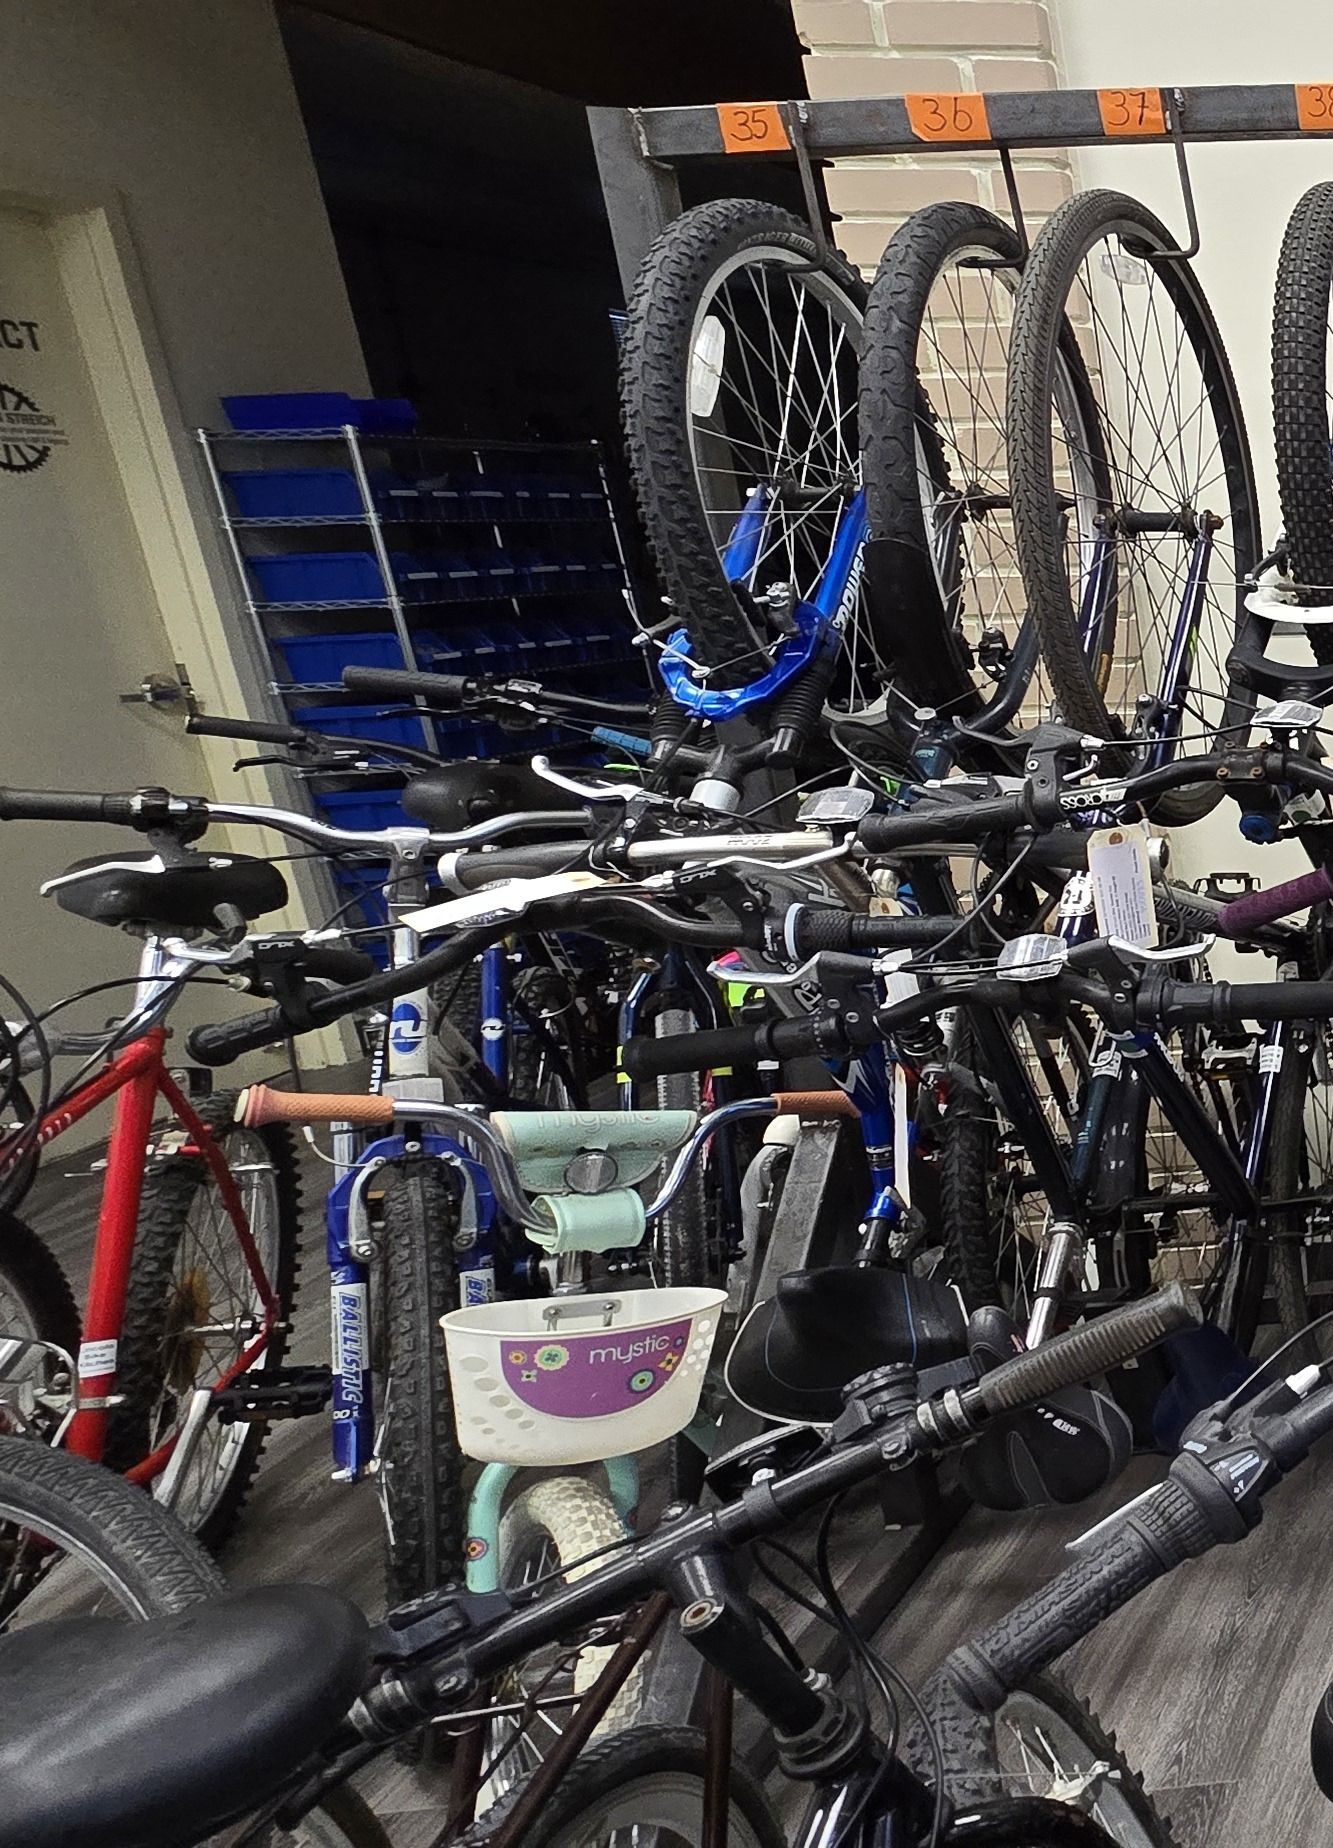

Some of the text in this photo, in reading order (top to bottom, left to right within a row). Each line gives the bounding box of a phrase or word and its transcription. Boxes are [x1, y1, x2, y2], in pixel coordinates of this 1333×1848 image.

[730, 108, 769, 140] 35
[922, 97, 972, 132] 36
[1107, 91, 1150, 126] 37
[0, 319, 41, 352] CT
[339, 1292, 363, 1404] BALLISTIC
[589, 1334, 670, 1364] mystic
